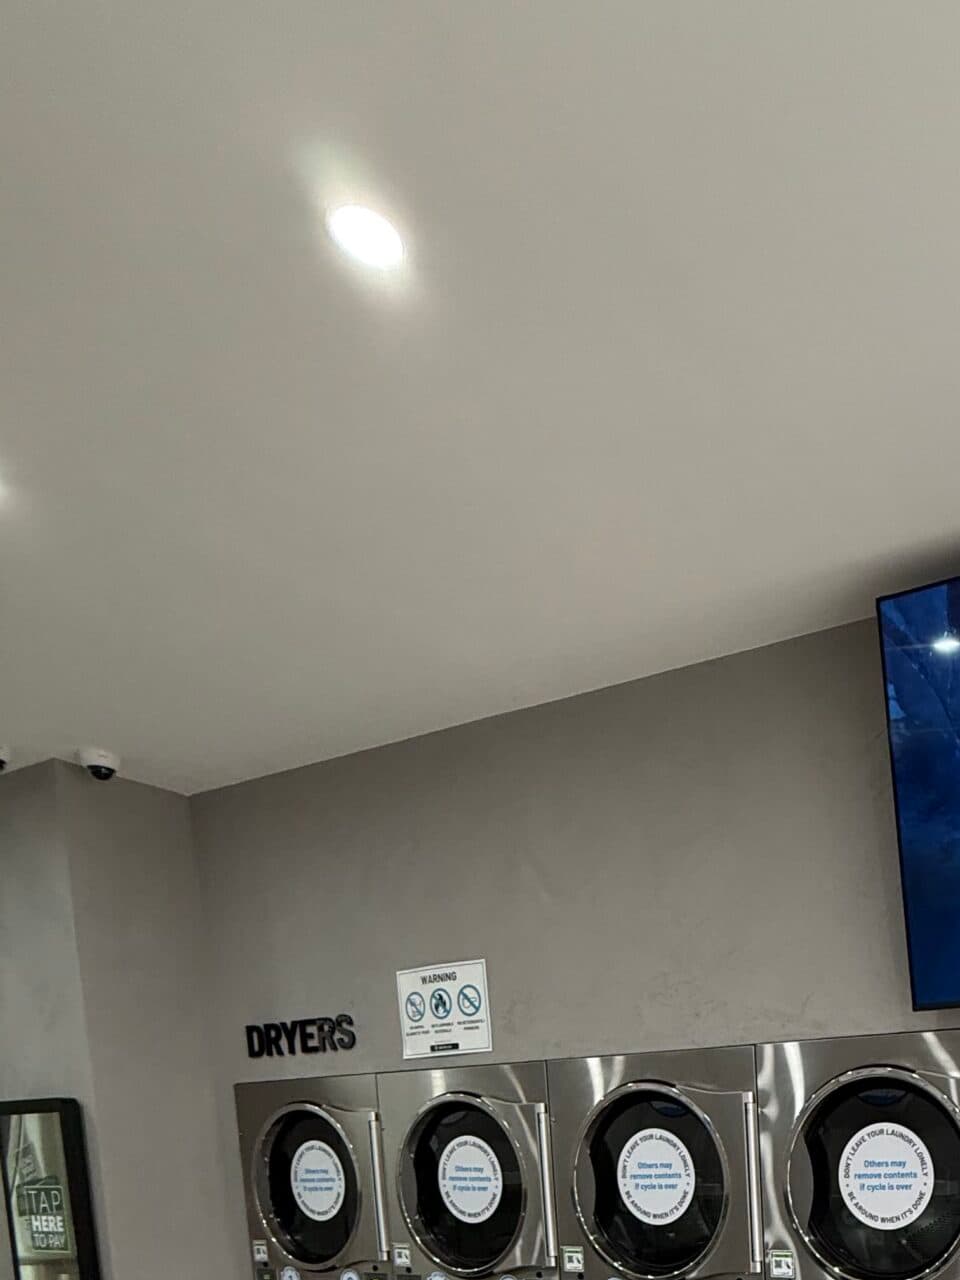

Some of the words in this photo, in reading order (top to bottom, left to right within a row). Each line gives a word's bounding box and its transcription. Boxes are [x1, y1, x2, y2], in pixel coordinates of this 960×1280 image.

[421, 972, 457, 984] WARNING
[246, 1014, 356, 1058] DRYERS
[28, 1191, 61, 1214] TAP
[32, 1215, 64, 1232] HERE
[33, 1234, 47, 1247] TO
[49, 1234, 65, 1248] PAY
